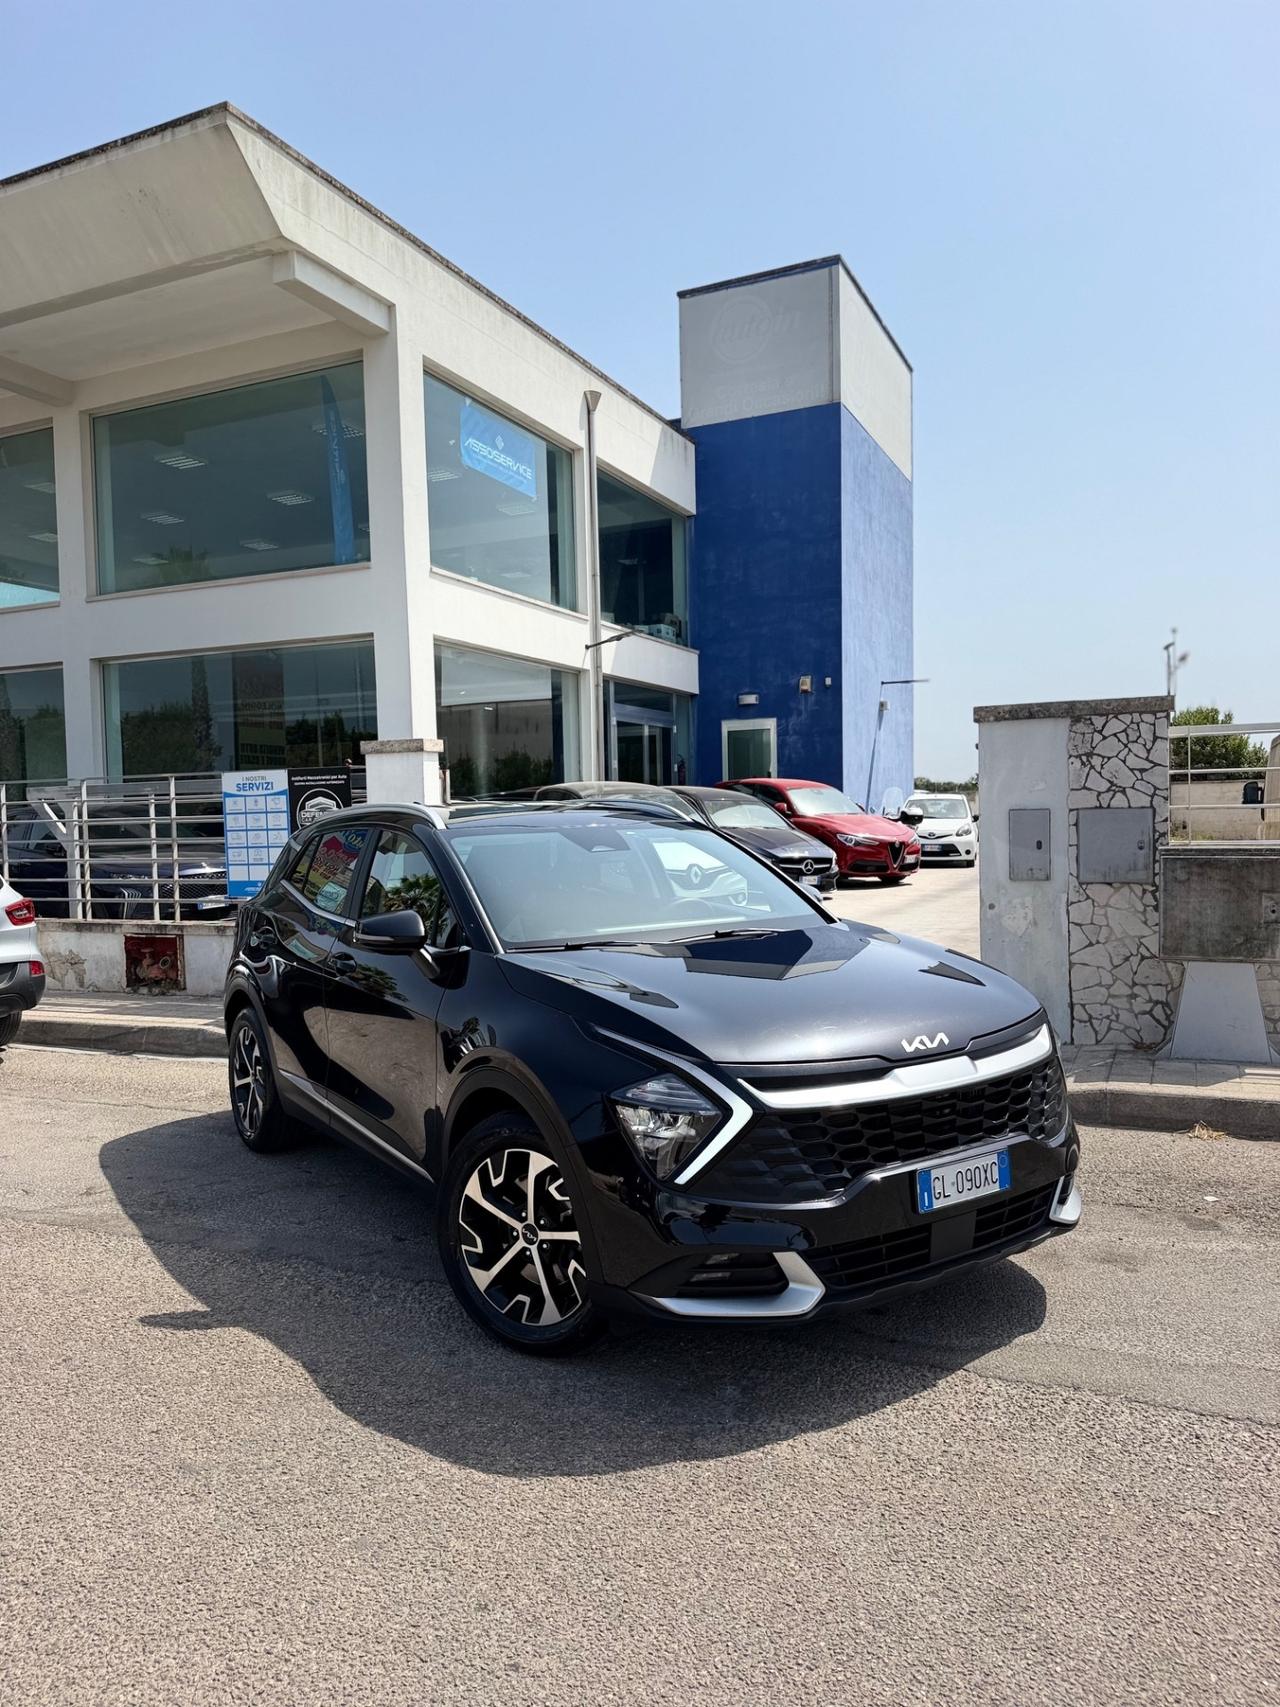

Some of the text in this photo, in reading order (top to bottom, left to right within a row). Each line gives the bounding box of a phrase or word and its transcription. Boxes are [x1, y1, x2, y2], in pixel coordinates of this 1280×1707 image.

[236, 782, 274, 791] SERVIZI
[901, 1032, 949, 1053] KIA
[932, 1160, 999, 1200] GL 090XC
